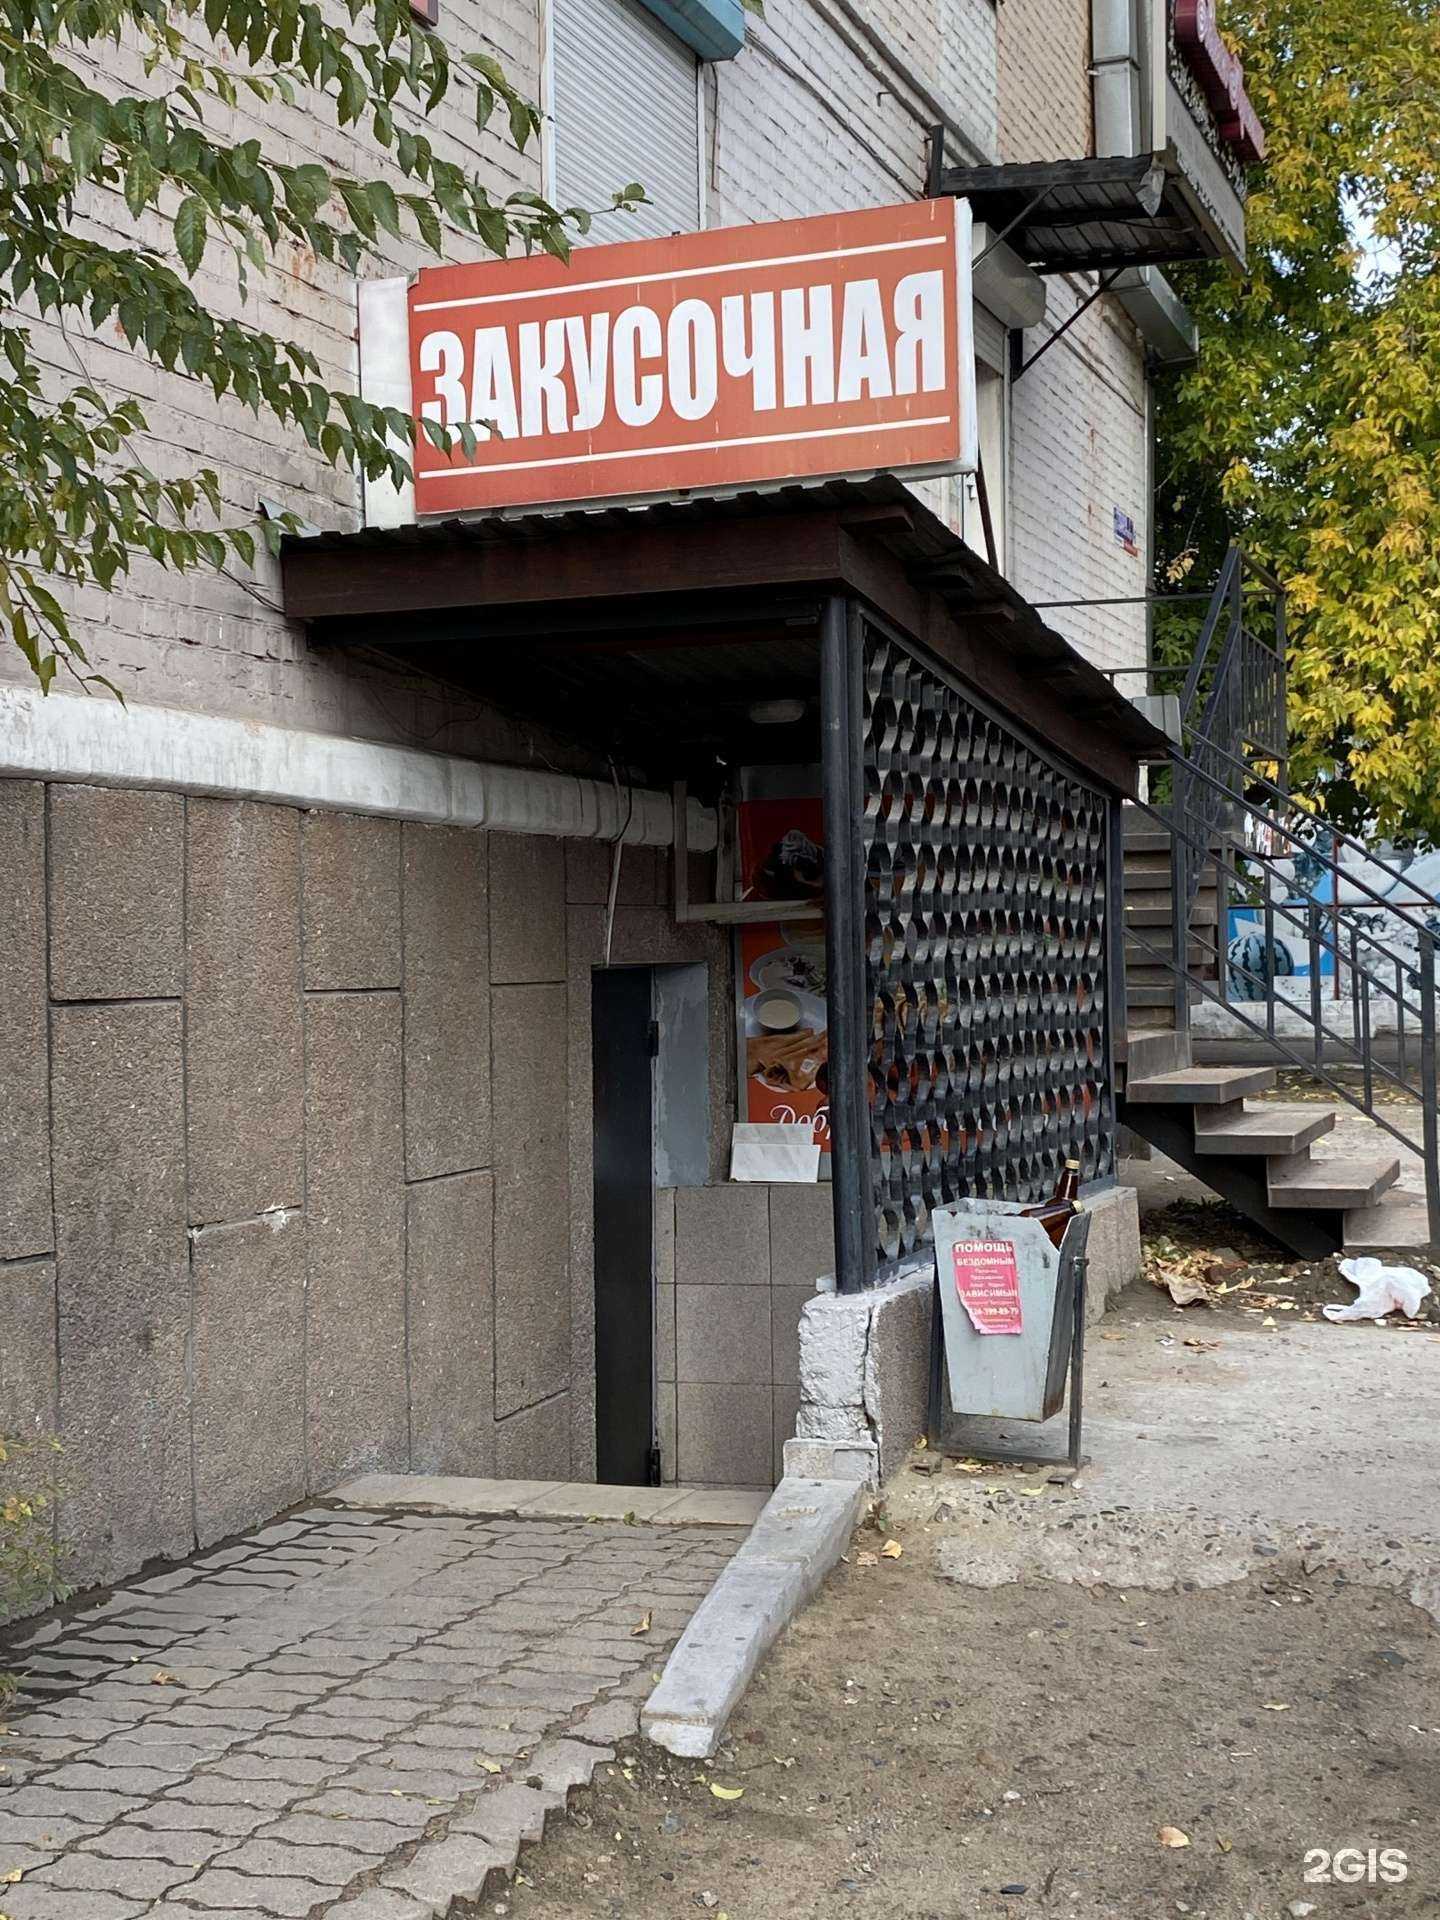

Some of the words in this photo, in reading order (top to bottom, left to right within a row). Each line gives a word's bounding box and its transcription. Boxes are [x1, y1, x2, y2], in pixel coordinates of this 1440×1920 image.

[419, 269, 946, 445] ЗАКУСОЧНАЯ
[955, 1242, 1013, 1253] ПОМОЩЬ
[956, 1257, 1015, 1266] БЕЗДОМНЫМ
